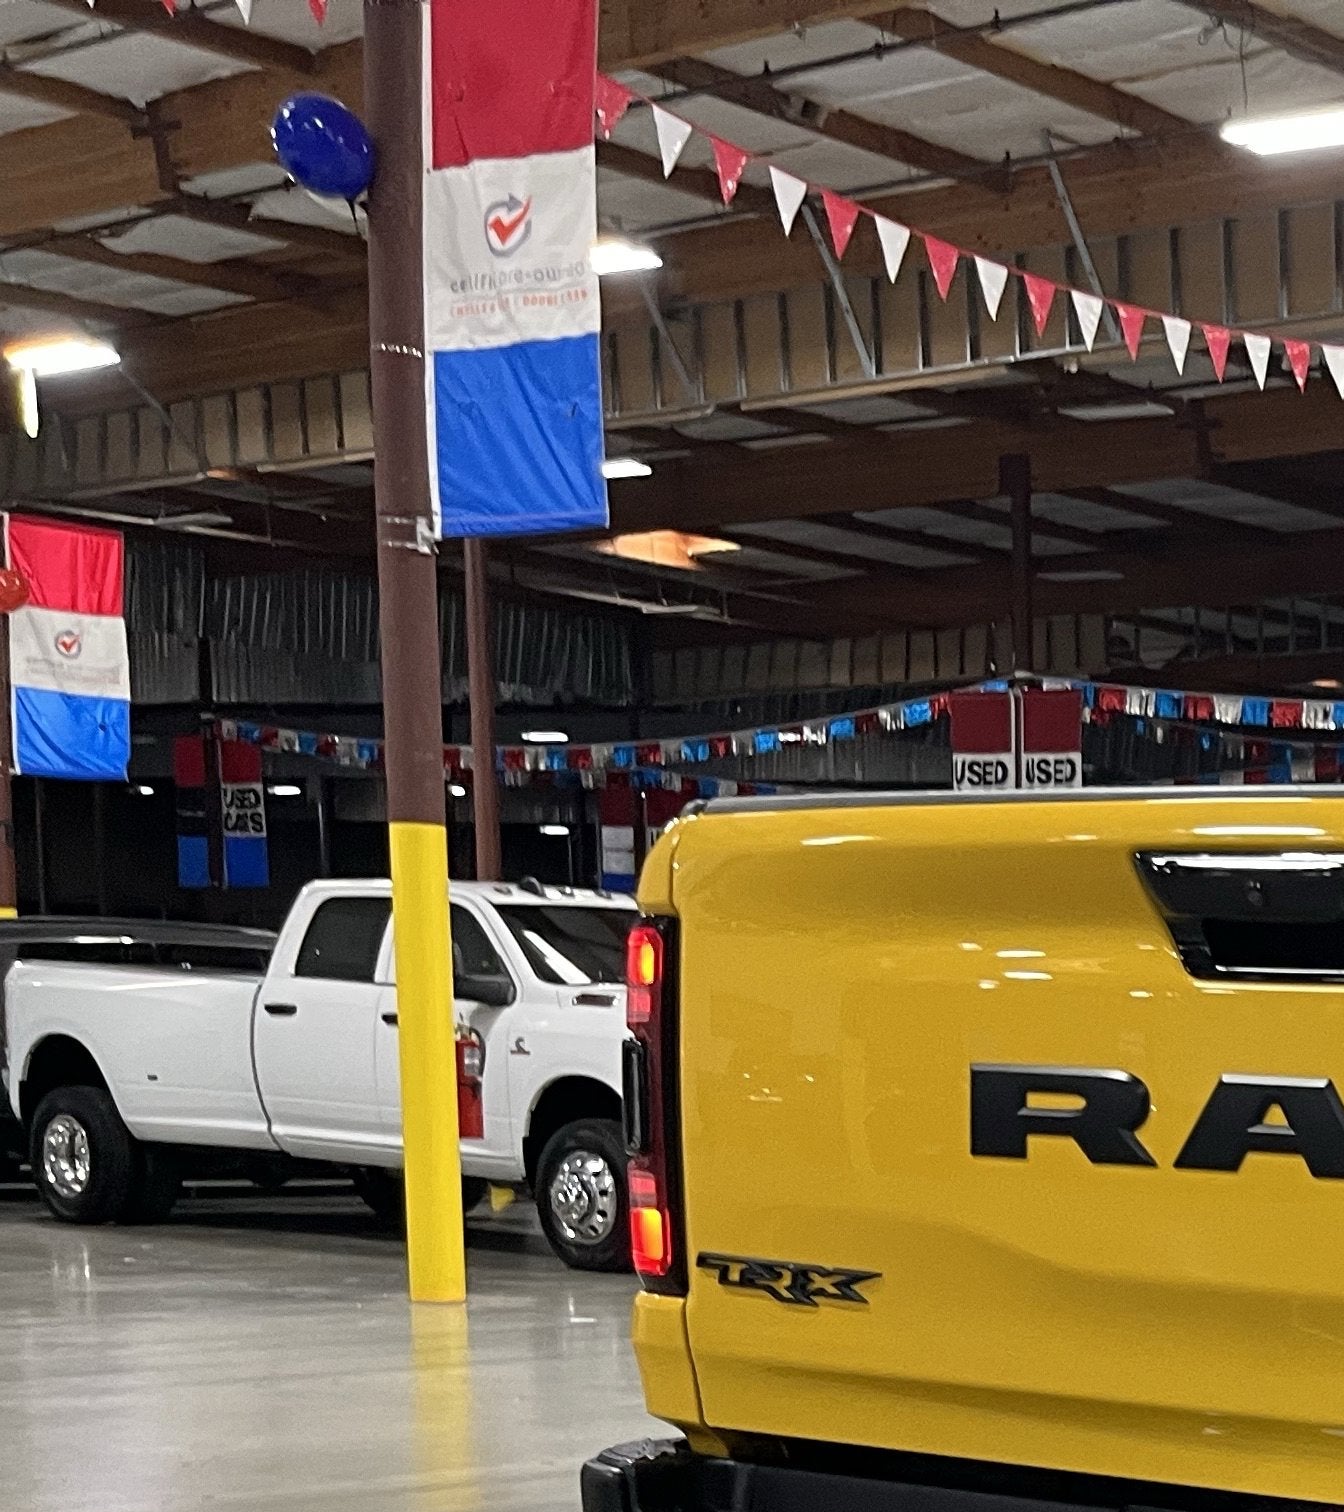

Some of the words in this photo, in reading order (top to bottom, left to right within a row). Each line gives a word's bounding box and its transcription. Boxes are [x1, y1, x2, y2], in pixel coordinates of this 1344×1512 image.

[954, 758, 1008, 785] USED
[1026, 758, 1076, 784] USED
[696, 1251, 882, 1307] TRX
